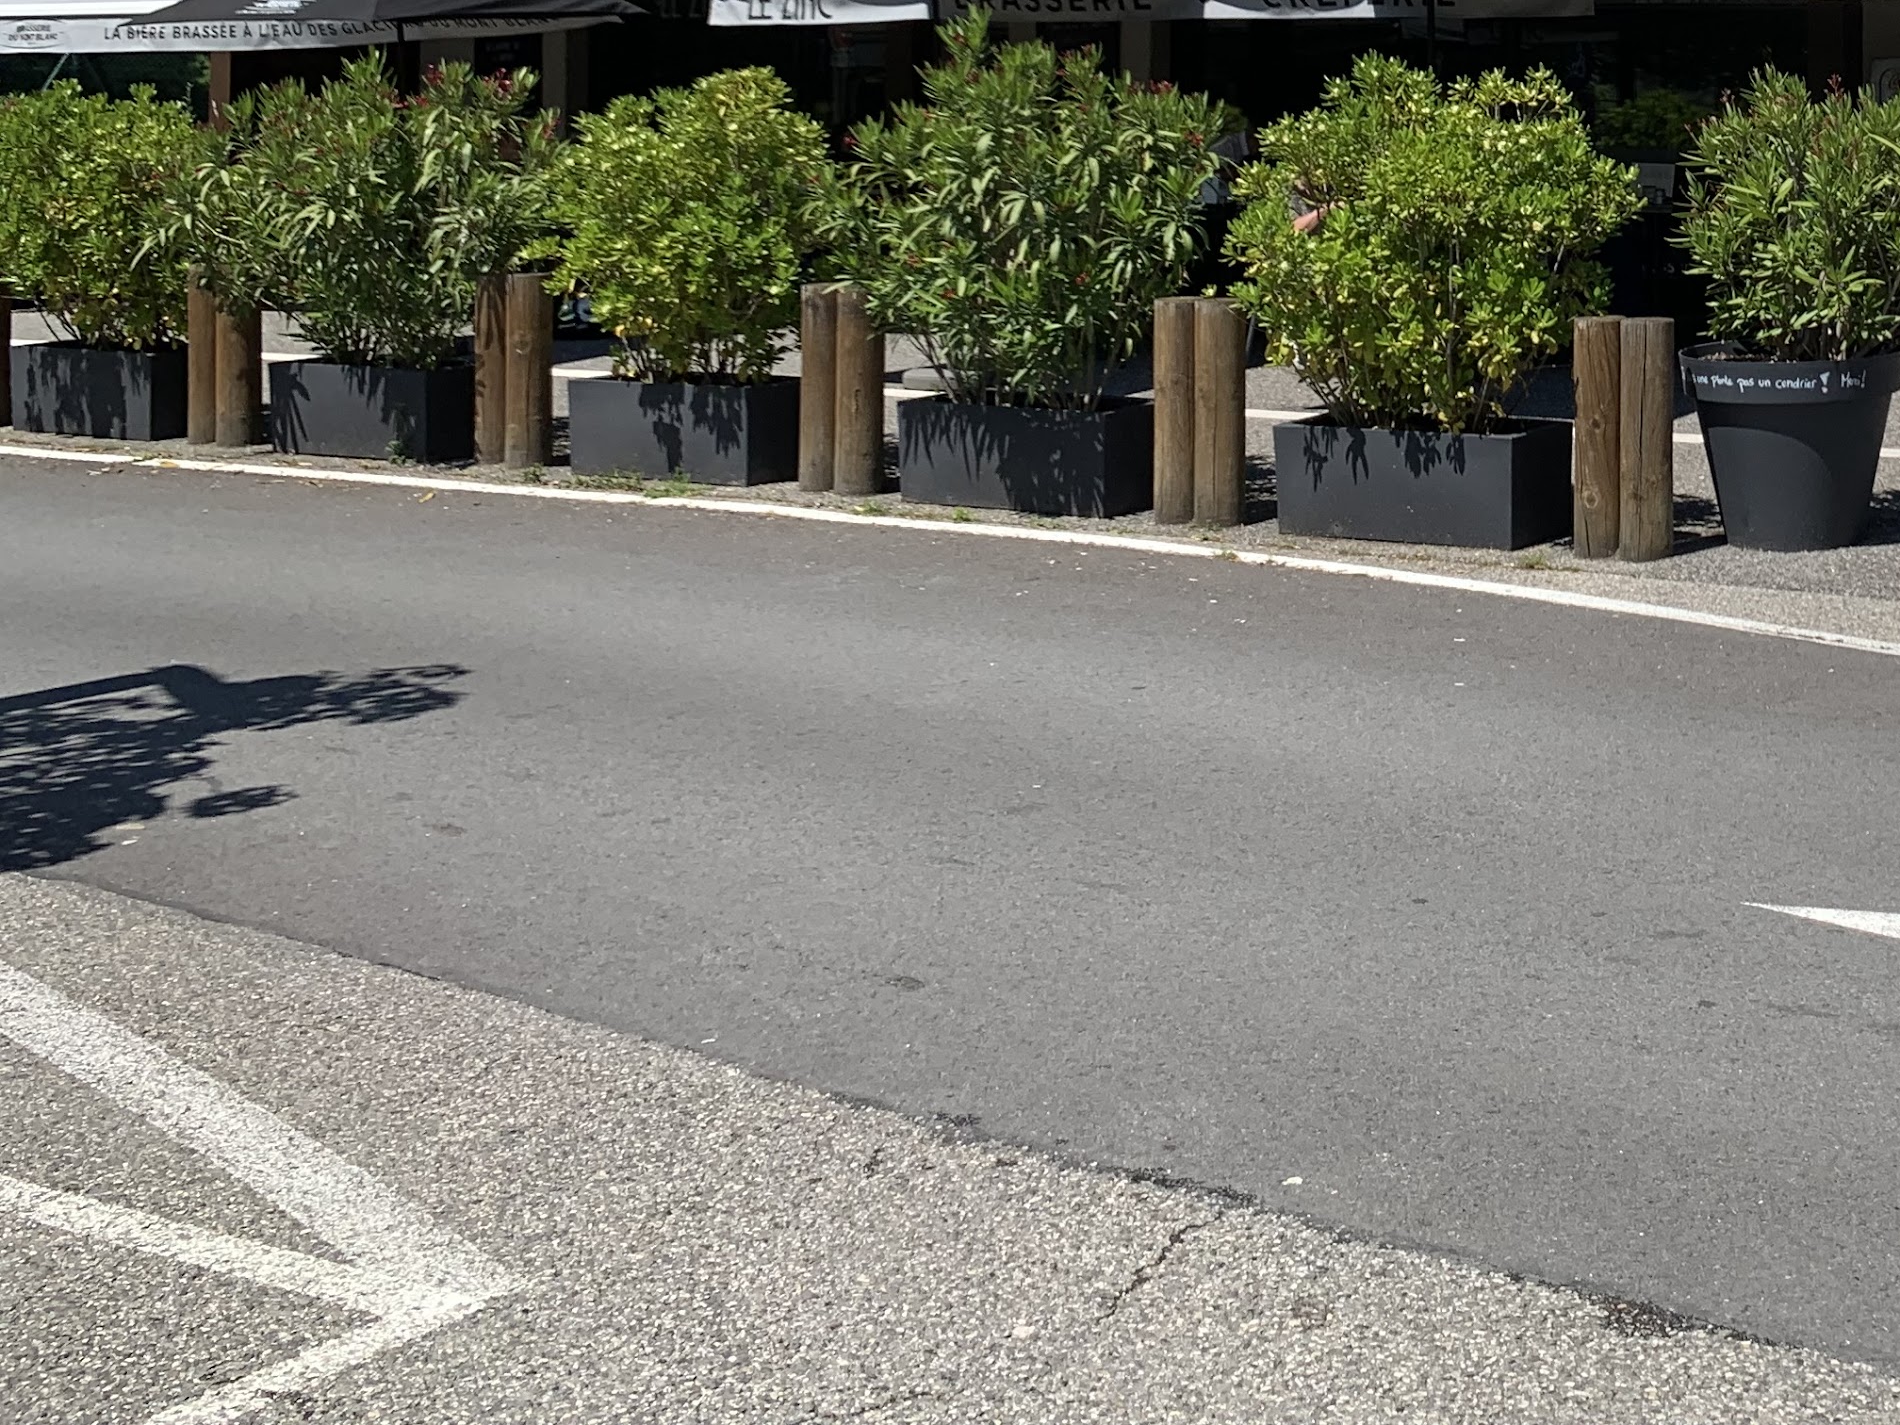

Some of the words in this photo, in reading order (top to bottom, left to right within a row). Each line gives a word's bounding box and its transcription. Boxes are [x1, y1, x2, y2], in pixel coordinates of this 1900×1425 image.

[104, 25, 121, 40] LA
[307, 23, 338, 36] DES
[1758, 378, 1772, 388] un
